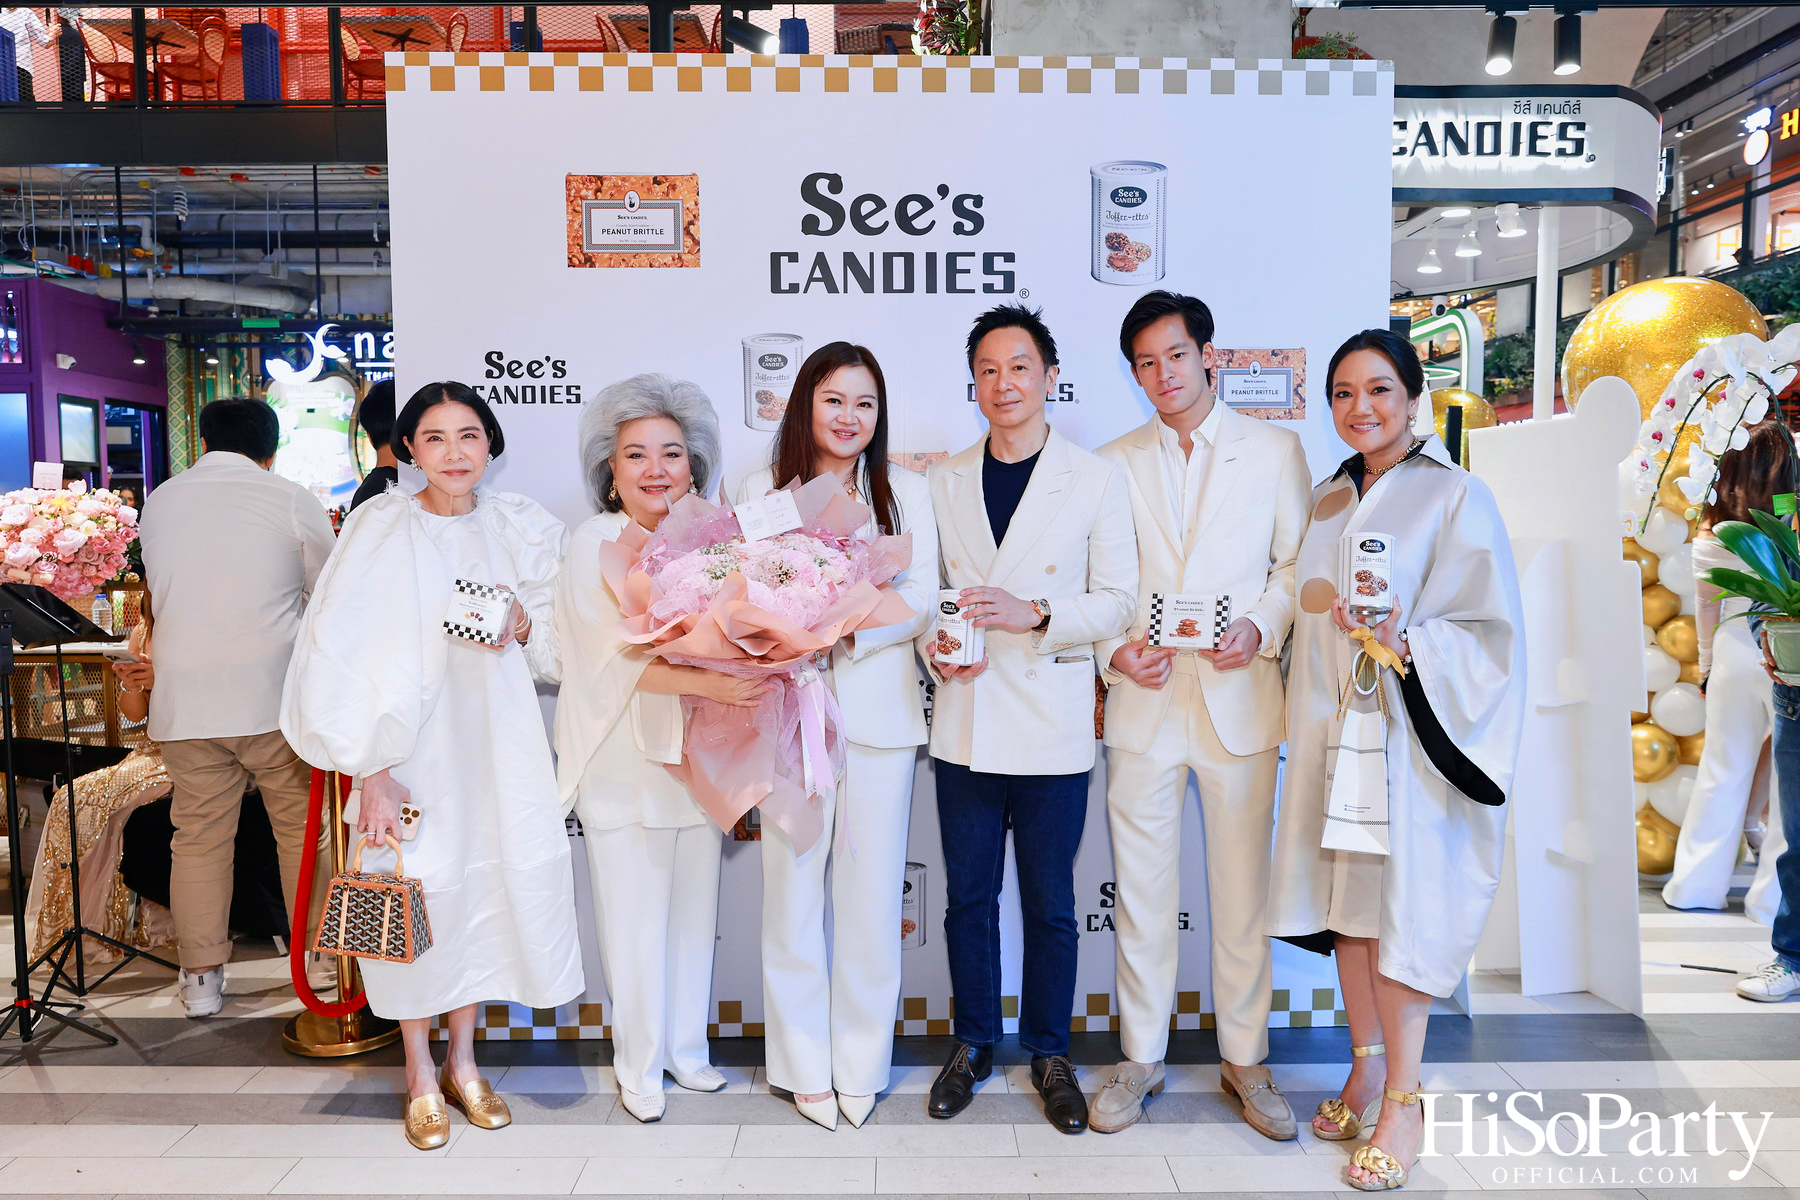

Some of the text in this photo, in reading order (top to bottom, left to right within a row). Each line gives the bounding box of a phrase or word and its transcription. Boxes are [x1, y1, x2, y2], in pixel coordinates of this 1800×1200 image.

[800, 172, 985, 236] See's
[1118, 189, 1140, 198] See's
[484, 350, 567, 379] See's
